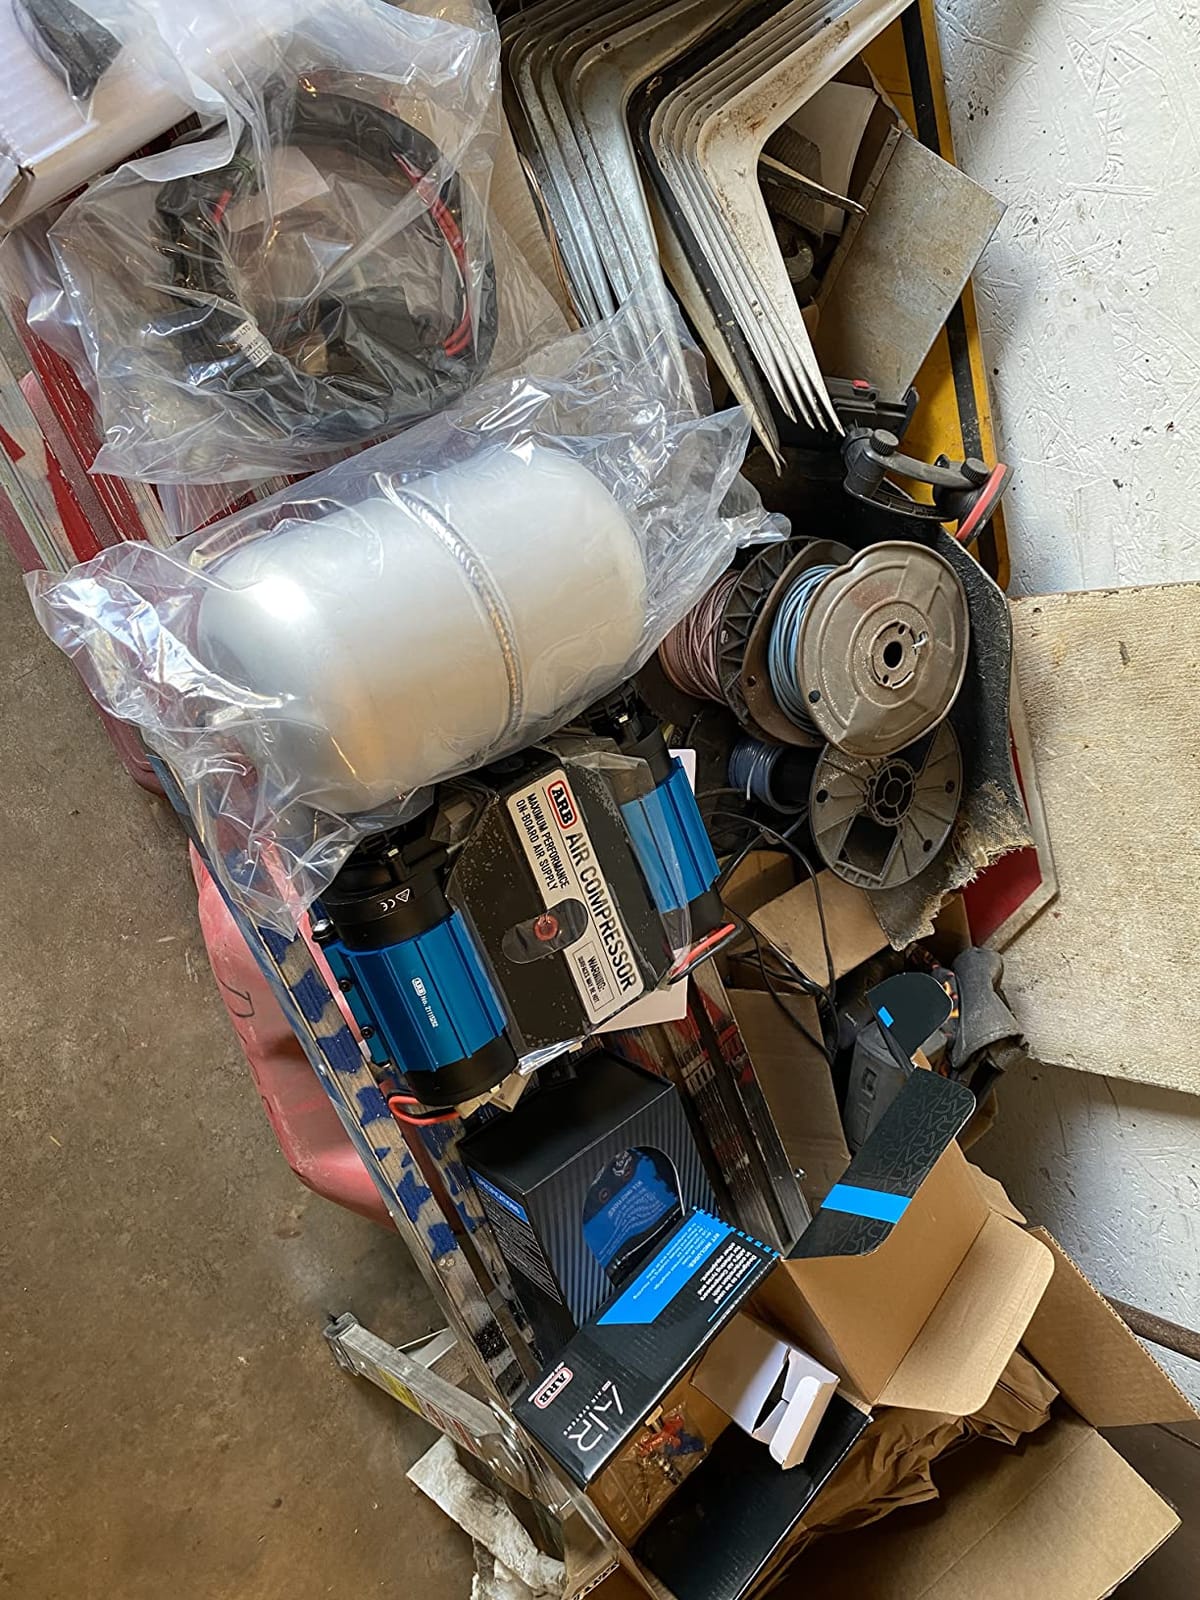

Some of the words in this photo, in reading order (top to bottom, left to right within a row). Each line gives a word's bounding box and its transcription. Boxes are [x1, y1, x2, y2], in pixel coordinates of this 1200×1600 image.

[514, 799, 538, 843] ON-BOARD
[525, 792, 548, 833] MAXIMUM
[539, 831, 570, 889] PERFORMANCE
[531, 842, 546, 859] AIR
[538, 858, 558, 892] SUPPLY
[550, 787, 575, 825] ARB
[564, 829, 590, 866] AIR
[577, 865, 639, 992] COMPRESSOR
[586, 955, 606, 993] WARNING:
[714, 1251, 735, 1273] inflating
[719, 1254, 747, 1286] conjunction
[733, 1253, 757, 1279] Designed
[697, 1267, 728, 1301] Compressors
[723, 1281, 733, 1291] be
[729, 1275, 738, 1284] to
[712, 1288, 727, 1304] used
[537, 1371, 567, 1404] ARB
[589, 1390, 603, 1404] AIR
[566, 1383, 623, 1453] AIR
